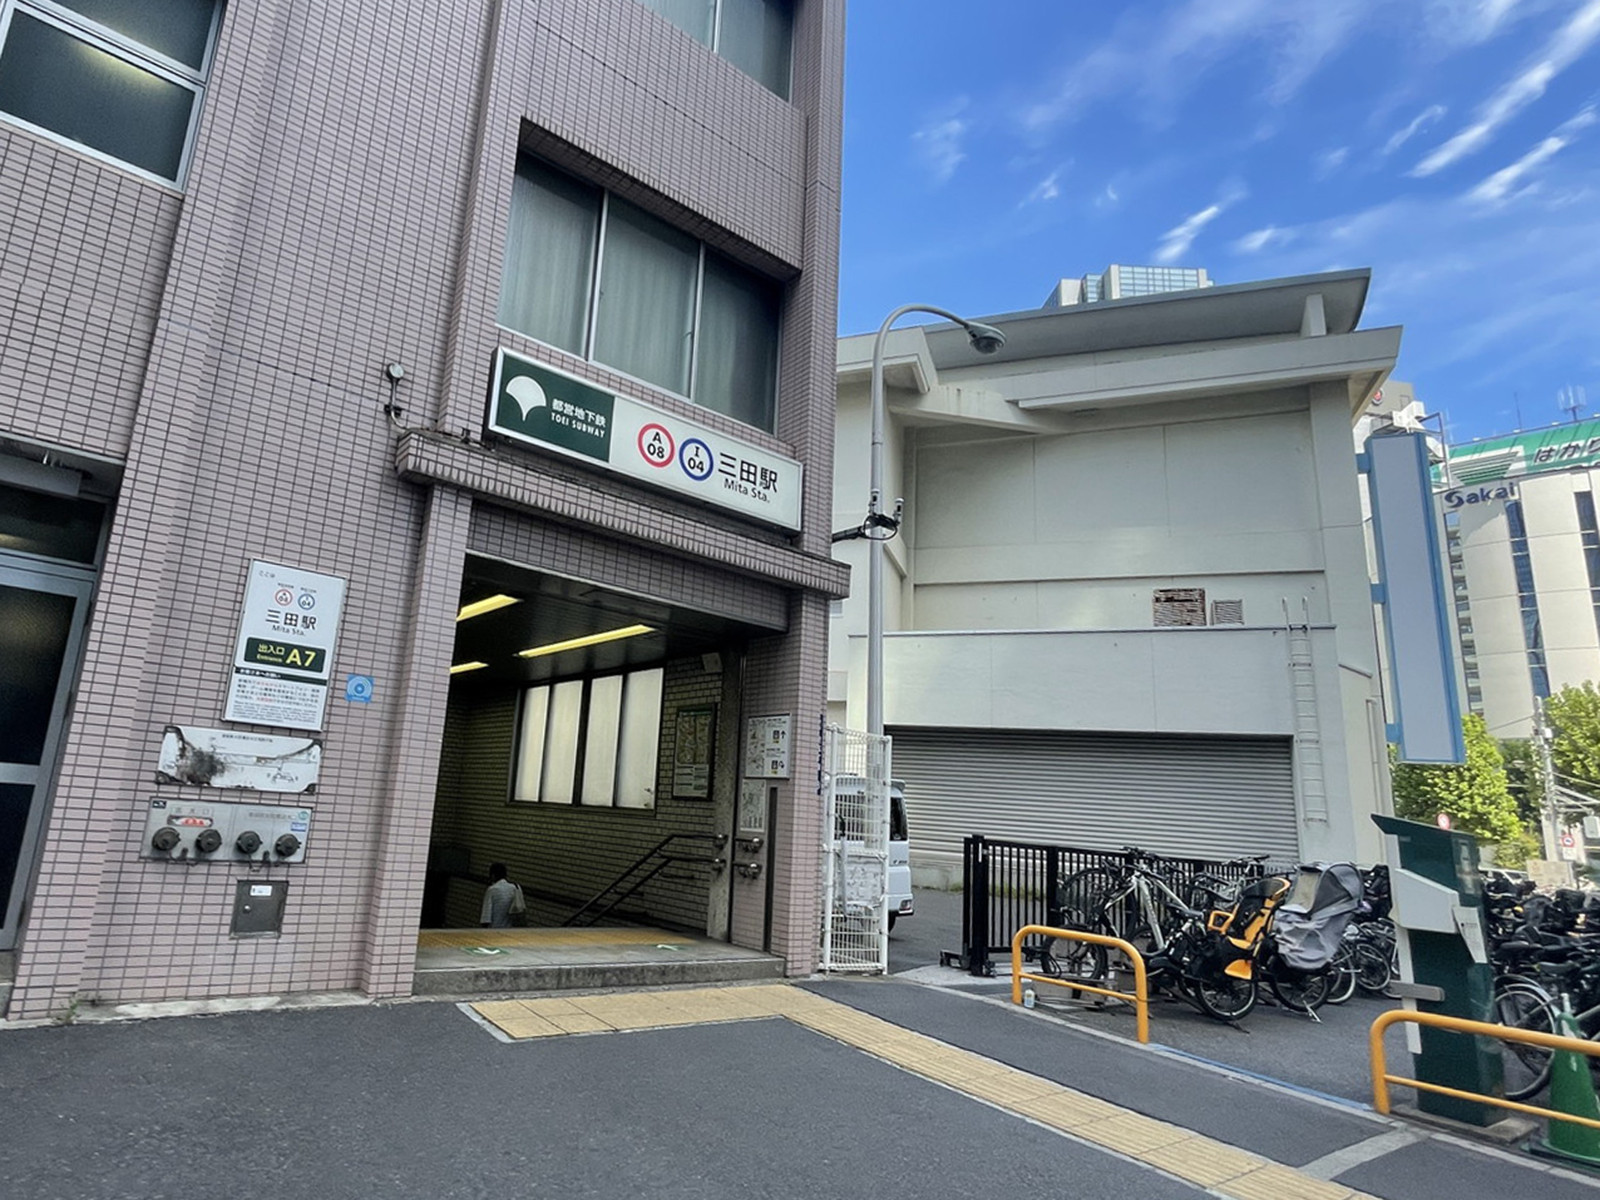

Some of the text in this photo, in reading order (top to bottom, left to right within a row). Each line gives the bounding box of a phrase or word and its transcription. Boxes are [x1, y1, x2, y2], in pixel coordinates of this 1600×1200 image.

[552, 398, 606, 428] 都営地下鉄
[551, 412, 605, 438] TOEI SUBWAY
[652, 432, 662, 444] A
[647, 443, 665, 459] 08
[694, 446, 700, 457] I
[688, 458, 704, 473] 04
[718, 452, 778, 493] 三田駅
[724, 478, 770, 503] Mita Sta.
[1444, 482, 1514, 508] Sakai
[265, 609, 317, 630] 三田駅
[258, 644, 285, 655] 出入口
[286, 648, 316, 667] A7
